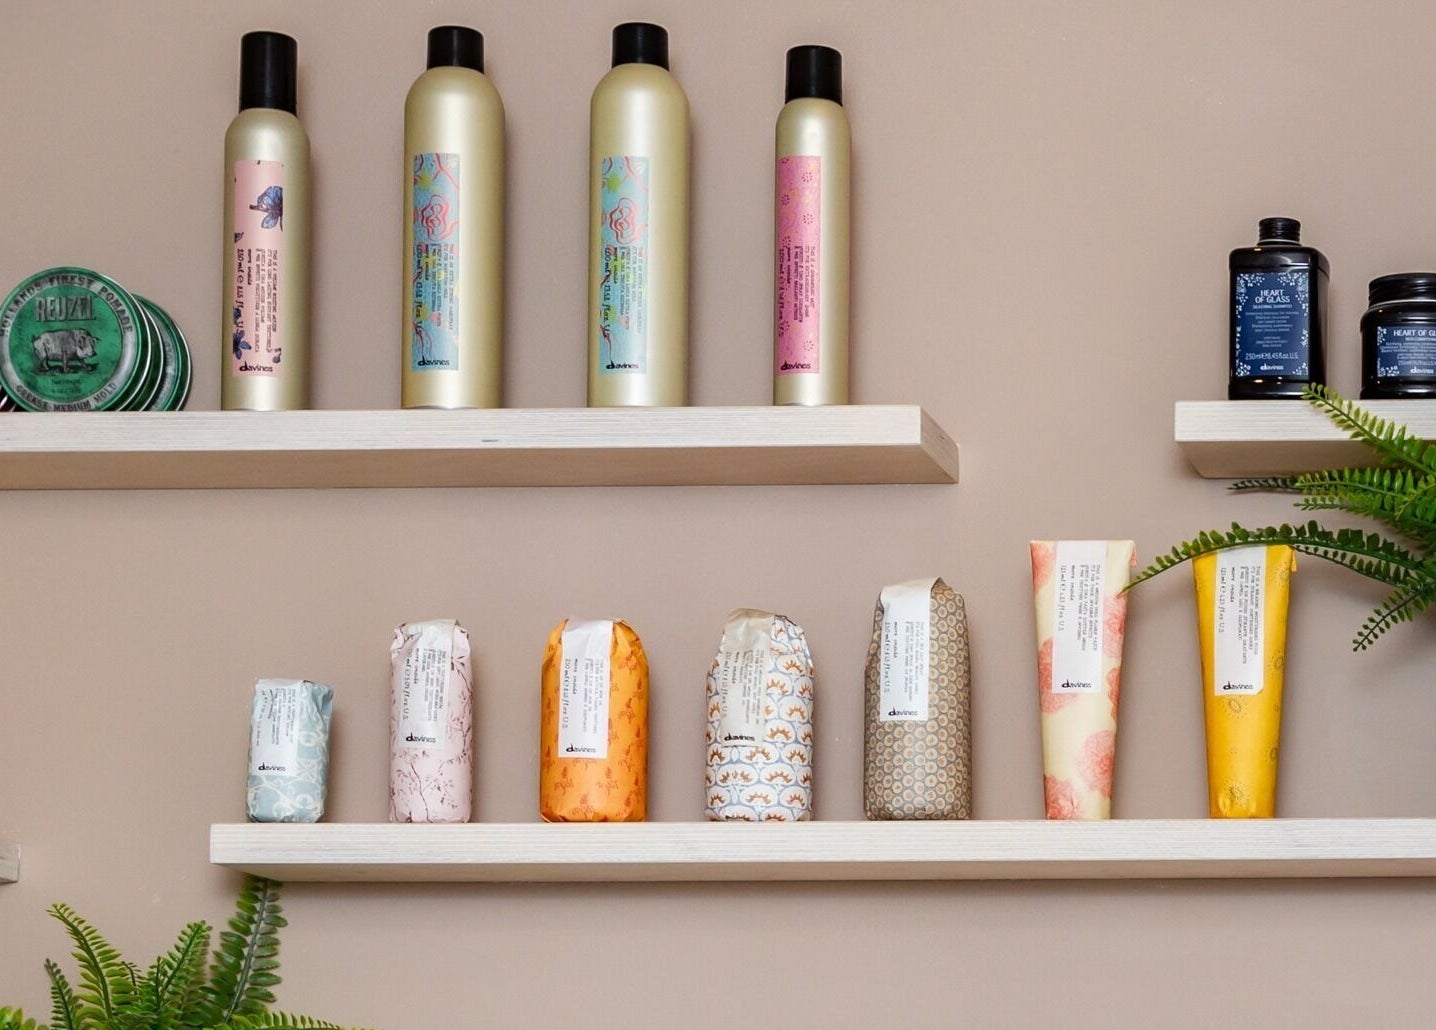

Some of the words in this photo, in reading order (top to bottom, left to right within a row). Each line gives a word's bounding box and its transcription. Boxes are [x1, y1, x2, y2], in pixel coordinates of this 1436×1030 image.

[1260, 289, 1284, 297] HEART
[35, 295, 97, 322] REUZEL
[49, 274, 95, 289] FINEST
[99, 286, 133, 335] POMADE
[1393, 329, 1415, 337] HEART
[240, 361, 273, 372] davines
[418, 356, 450, 367] davines
[606, 360, 639, 370] davines
[781, 360, 811, 371] davines
[53, 400, 91, 412] MEDIUM
[93, 382, 117, 405] HOLD
[1061, 680, 1092, 690] davines
[1223, 681, 1253, 690] davines
[888, 707, 918, 716] davines
[405, 732, 437, 743] davines
[724, 732, 755, 741] davines
[566, 744, 597, 753] davines
[258, 762, 286, 772] davines
